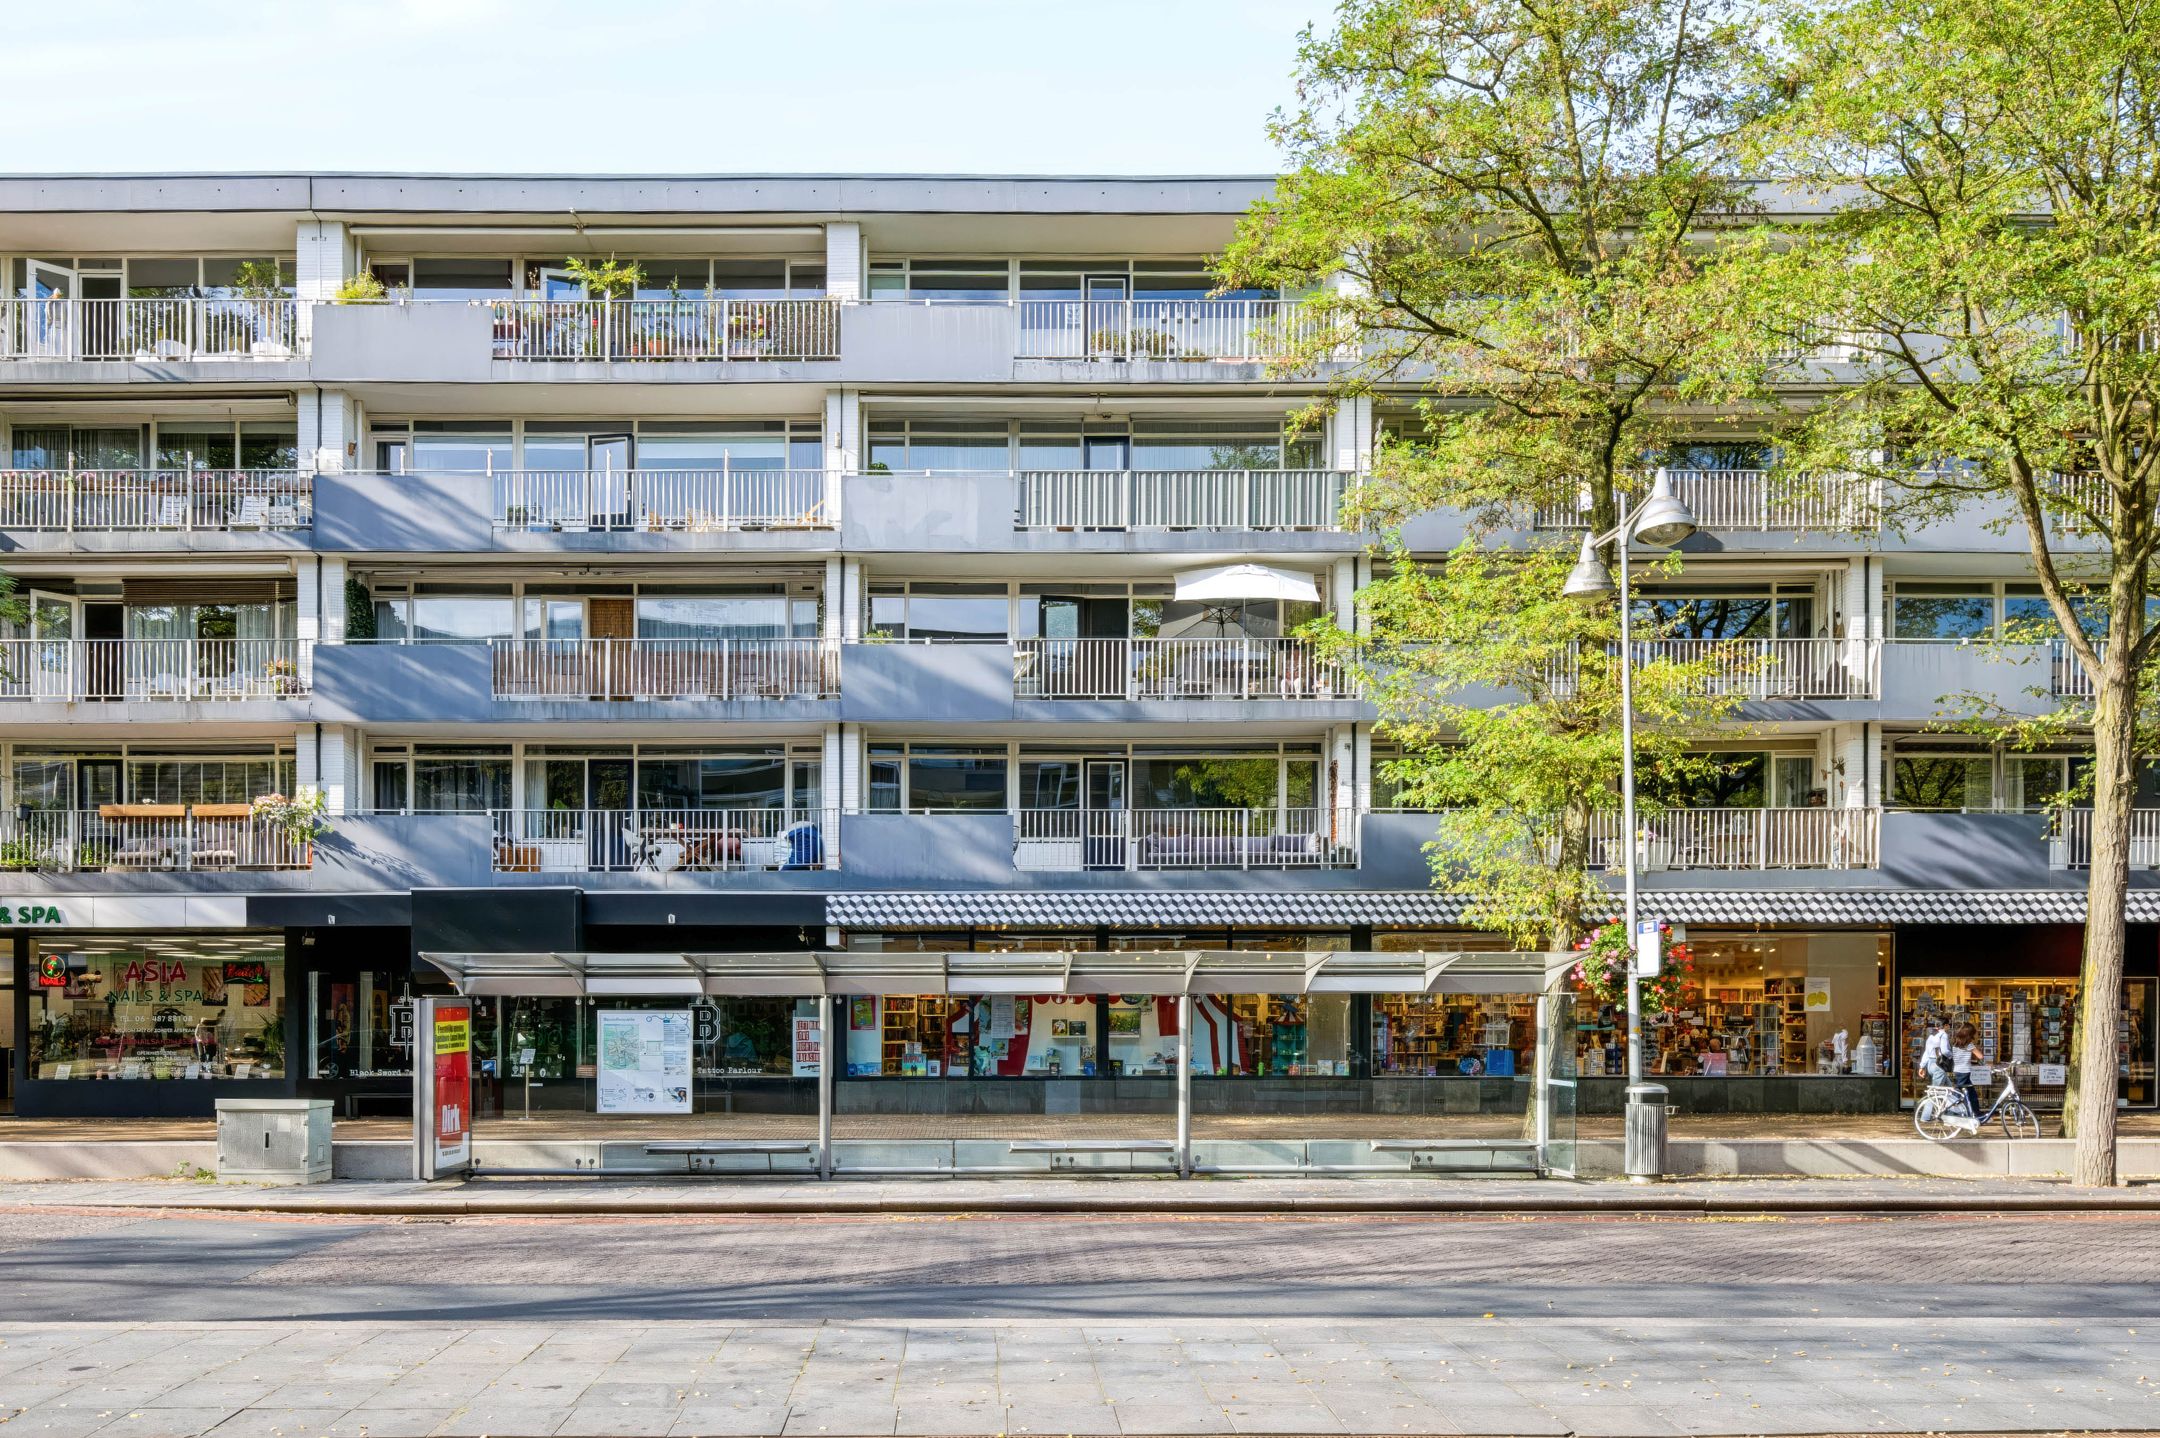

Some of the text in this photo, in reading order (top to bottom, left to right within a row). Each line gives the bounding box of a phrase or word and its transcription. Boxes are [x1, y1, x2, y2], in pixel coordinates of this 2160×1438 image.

[0, 906, 61, 924] & SPA
[125, 960, 187, 983] ASIA
[40, 976, 66, 986] NAILS
[109, 989, 203, 1002] NAILS & SPA
[350, 1069, 374, 1077] Black
[378, 1069, 401, 1077] Sword
[442, 1104, 460, 1133] Dirk
